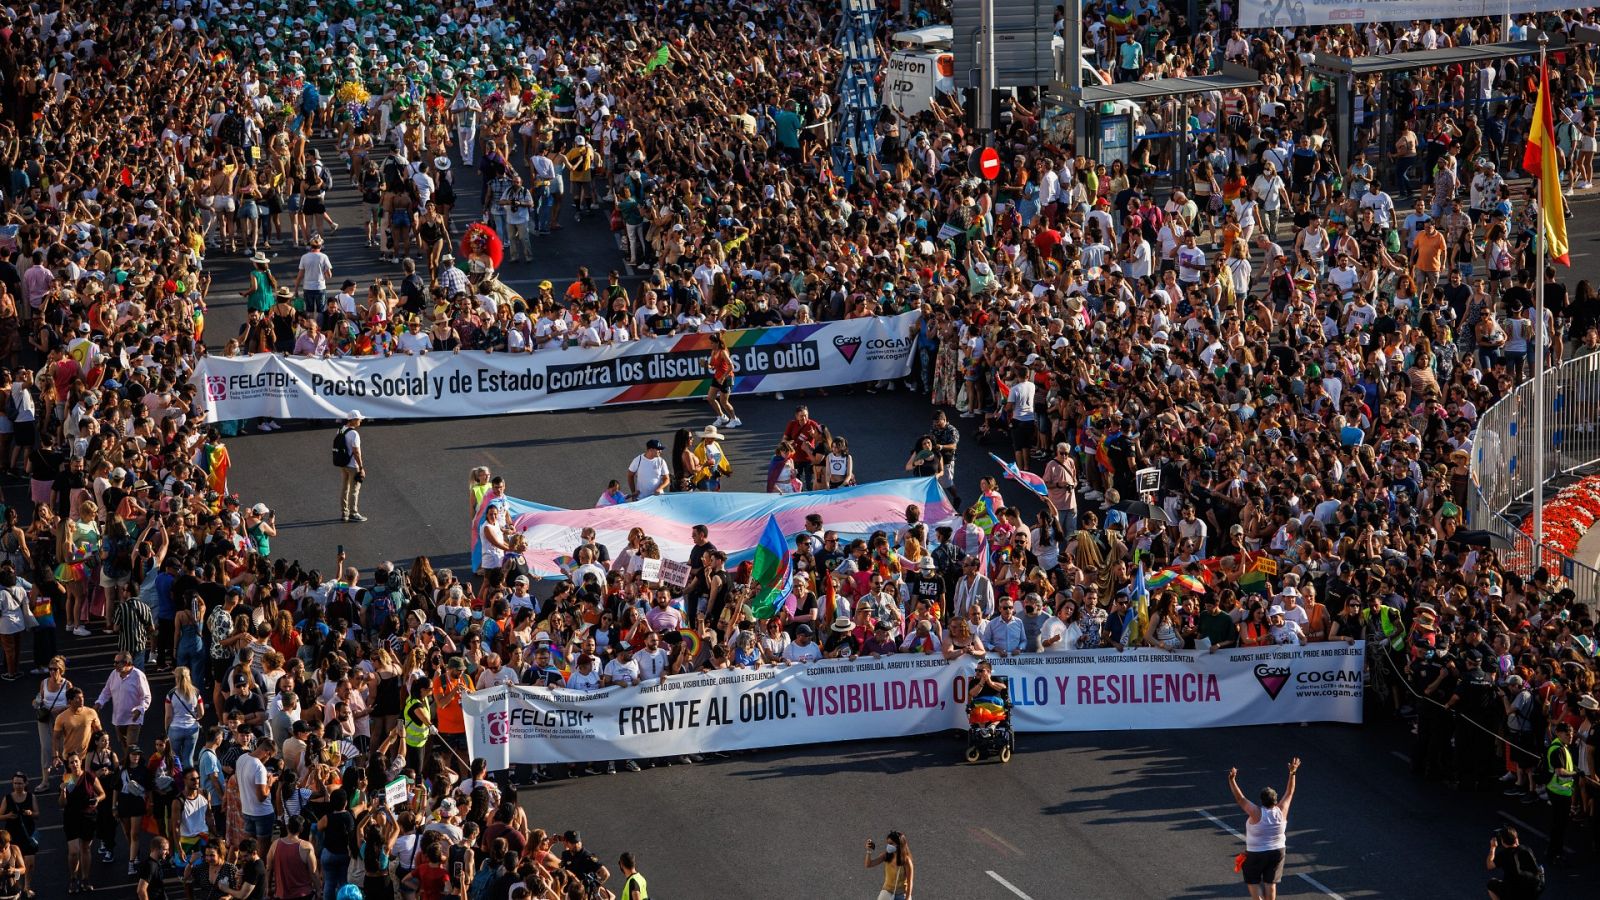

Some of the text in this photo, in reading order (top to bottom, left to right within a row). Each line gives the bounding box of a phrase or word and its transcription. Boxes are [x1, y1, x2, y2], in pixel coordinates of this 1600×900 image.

[890, 59, 925, 73] overon
[893, 79, 914, 92] HD
[866, 338, 912, 350] COGAM
[311, 373, 366, 397] Pacto
[371, 371, 428, 397] Social
[432, 375, 444, 400] y
[449, 369, 472, 394] de
[478, 367, 544, 392] Estado
[549, 365, 611, 391] contra
[616, 357, 643, 382] los
[745, 346, 769, 372] de
[774, 343, 816, 370] odio
[229, 372, 299, 390] FELGTBI+
[1046, 655, 1097, 665] IKUSGARRITASUNA,
[1098, 654, 1137, 664] HARROTASUNA
[1138, 654, 1150, 663] ETA
[1150, 654, 1195, 664] ERRESILIENTZIA
[1229, 653, 1254, 663] AGAINST
[1255, 652, 1272, 662] HATE:
[1272, 651, 1302, 661] VISIBILITY,
[1303, 649, 1320, 659] PRIDE
[1320, 648, 1333, 658] AND
[807, 666, 835, 676] ESCONTRA
[910, 660, 916, 669] Y
[916, 658, 950, 669] RESILIENCIA
[1257, 664, 1290, 676] COGAM
[668, 680, 682, 691] ODIO,
[683, 677, 718, 689] VISIBILIDADE,
[718, 674, 740, 686] ORGULLO
[745, 671, 776, 682] RESILIENCIA
[1296, 670, 1361, 683] COGAM
[487, 692, 506, 703] DAVAN
[618, 699, 702, 736] FRENTE
[706, 696, 733, 727] AL
[739, 689, 796, 723] ODIO:
[802, 678, 946, 717] VISIBILIDAD,
[1055, 675, 1070, 706] Y
[1077, 672, 1221, 705] RESILIENCIA
[510, 708, 593, 727] FELGTBI+
